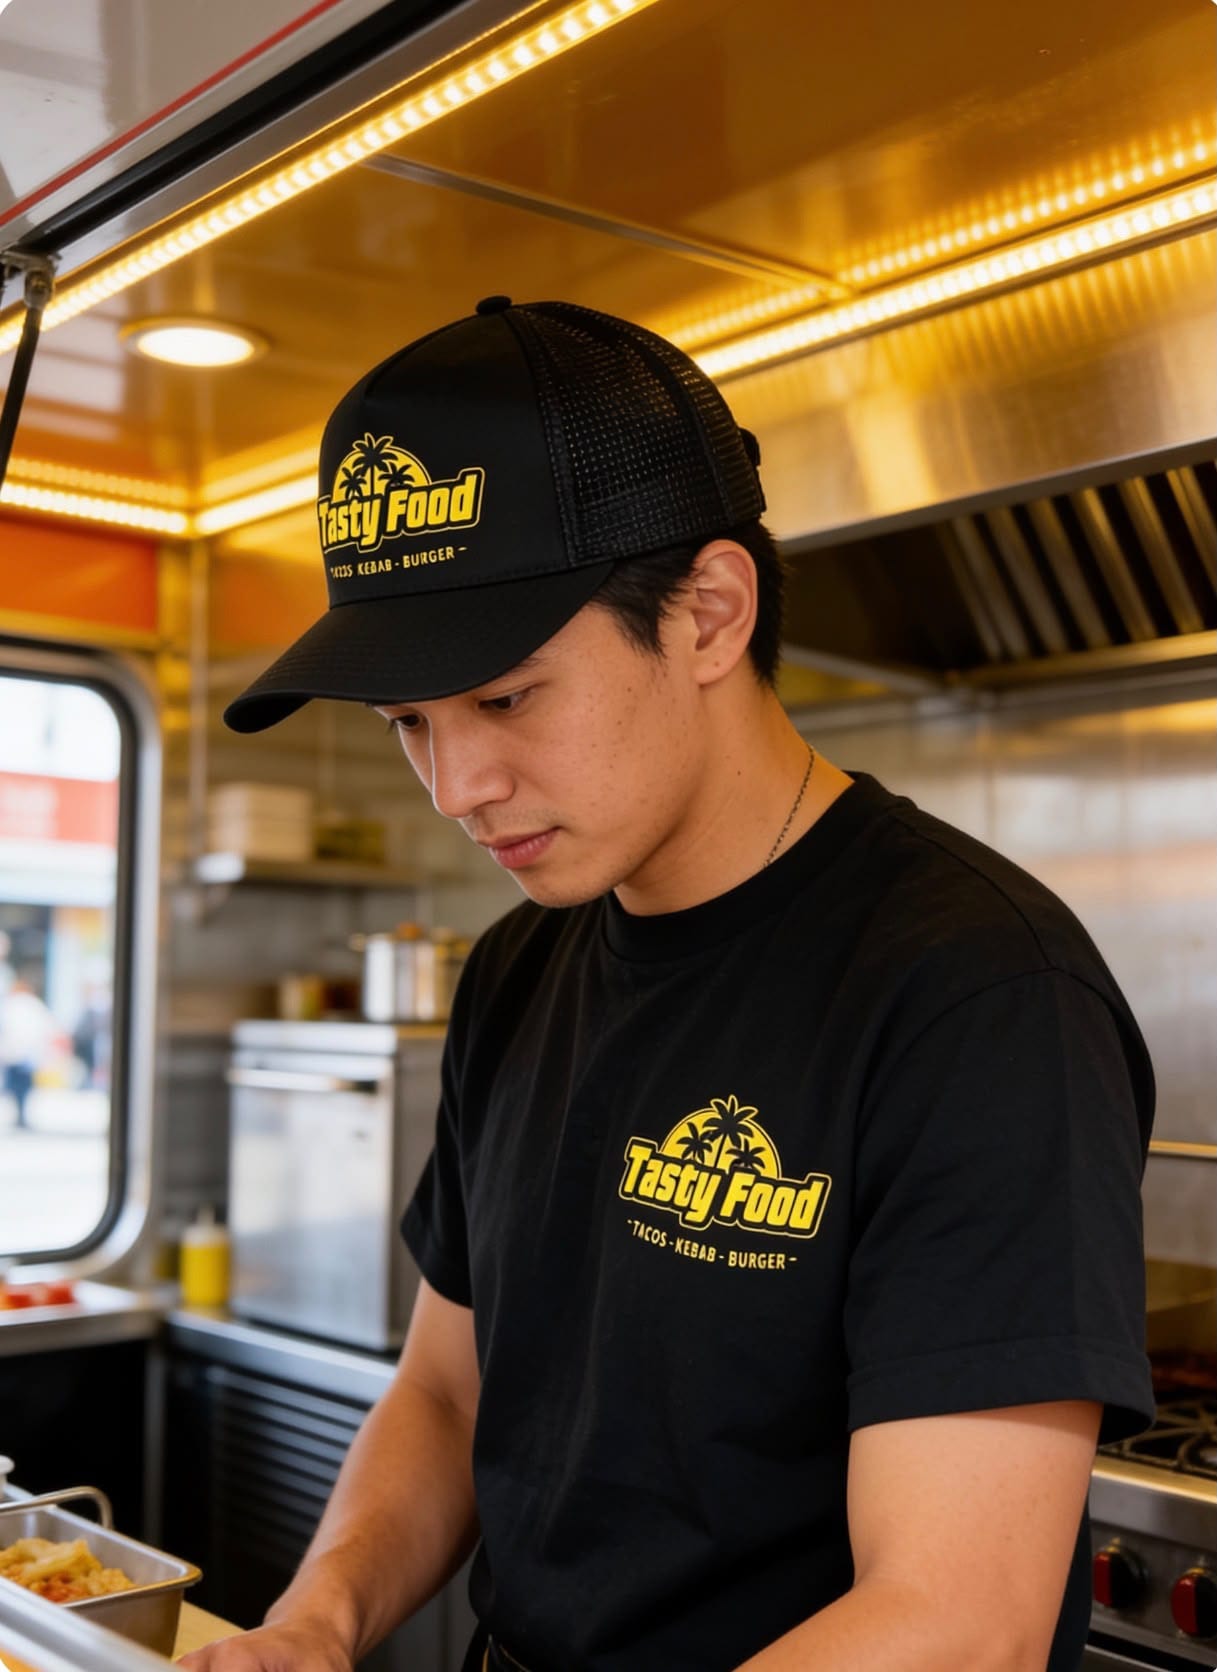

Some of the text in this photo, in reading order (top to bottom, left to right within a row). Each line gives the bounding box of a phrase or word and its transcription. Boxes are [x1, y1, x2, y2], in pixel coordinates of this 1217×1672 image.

[318, 473, 478, 547] Tasty Food
[357, 558, 393, 576] KEBAB
[402, 546, 455, 569] BURGER
[623, 1143, 825, 1230] Tasty Food
[633, 1219, 786, 1270] TACOS KEBAB BURGER
